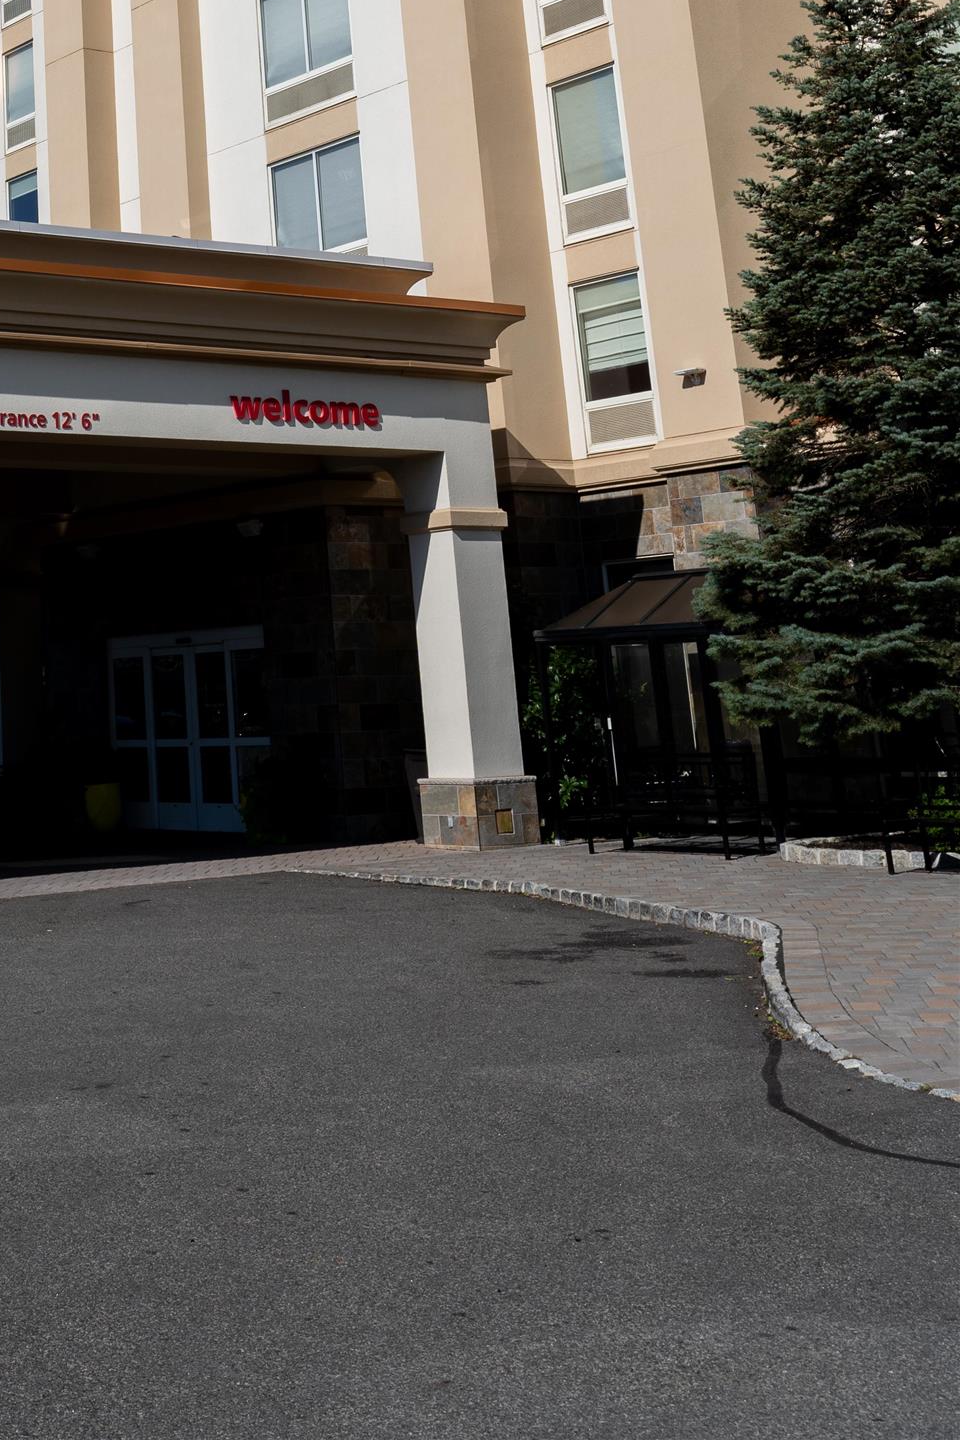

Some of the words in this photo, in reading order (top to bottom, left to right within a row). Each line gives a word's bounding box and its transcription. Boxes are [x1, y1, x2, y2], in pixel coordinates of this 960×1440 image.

[52, 411, 76, 430] 12'
[81, 412, 100, 431] 6"
[230, 389, 381, 428] welcome
